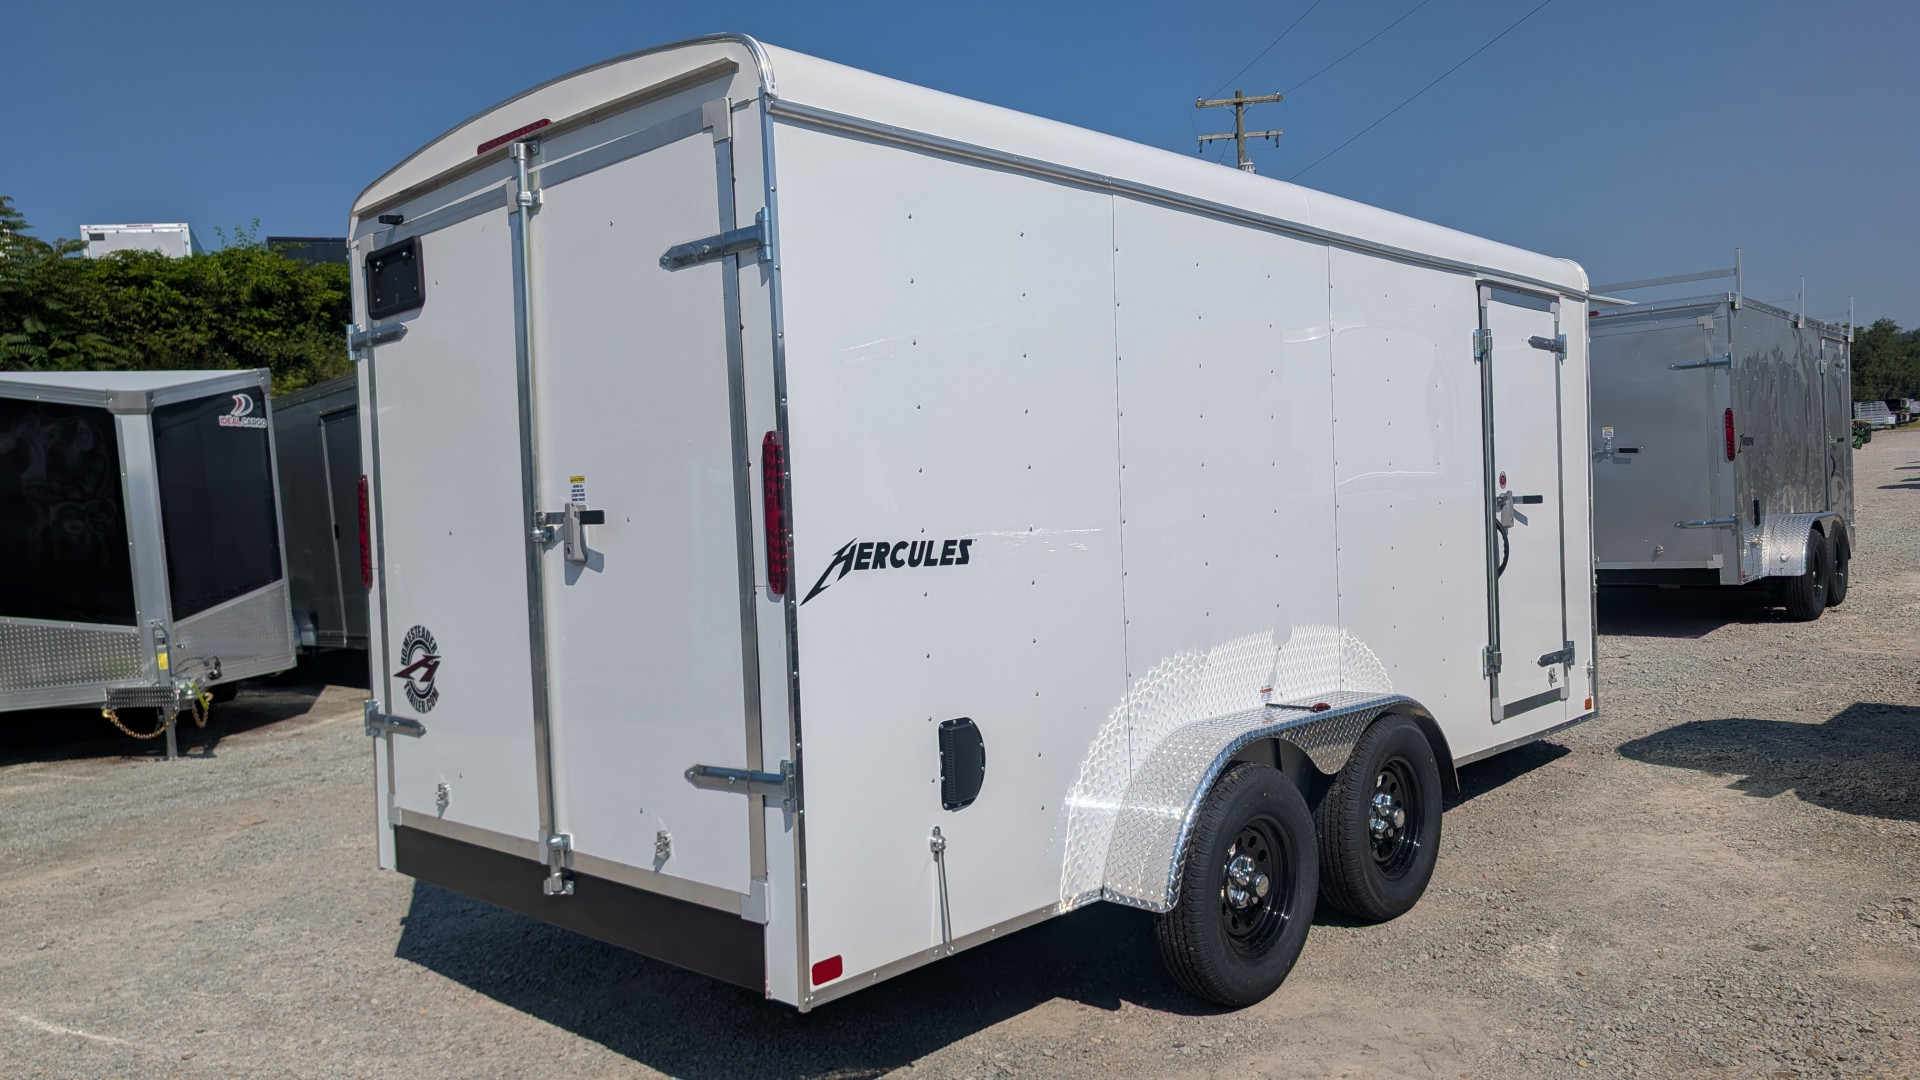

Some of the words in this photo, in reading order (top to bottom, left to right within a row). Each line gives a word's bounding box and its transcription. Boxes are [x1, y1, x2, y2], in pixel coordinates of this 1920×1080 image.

[219, 416, 241, 426] IDEAL
[242, 417, 267, 428] CARGO
[799, 537, 973, 606] HERCULES
[401, 625, 437, 666] HOMESTEADER
[404, 682, 440, 714] TRAILER.COM
